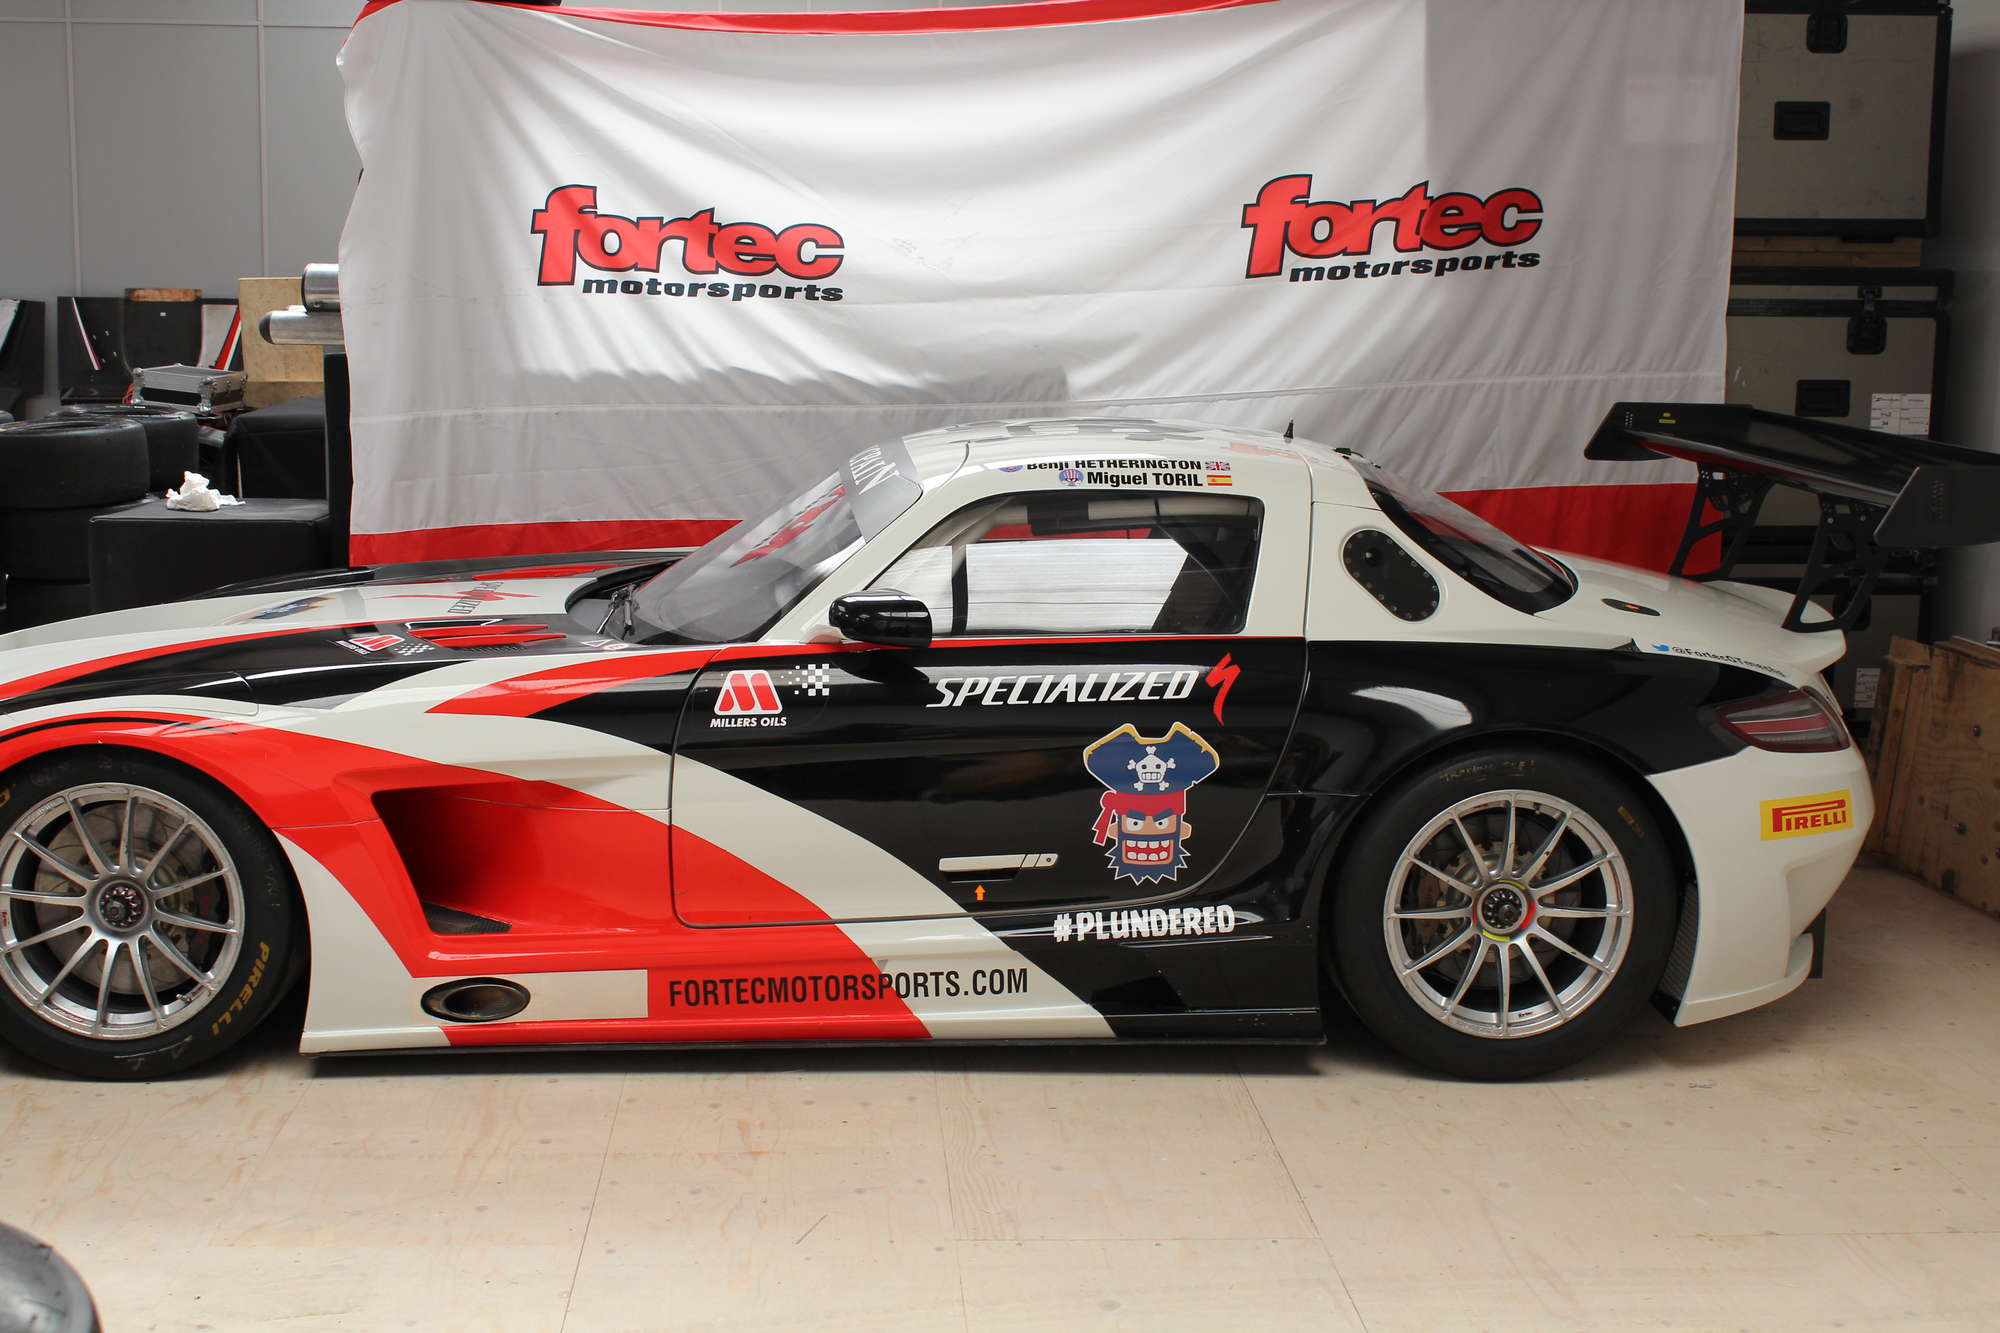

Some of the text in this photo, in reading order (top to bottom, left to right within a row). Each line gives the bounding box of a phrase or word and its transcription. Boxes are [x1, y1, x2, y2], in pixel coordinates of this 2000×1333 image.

[531, 184, 845, 286] fortec
[1241, 174, 1544, 279] fortec
[1289, 250, 1540, 282] motorsports
[582, 277, 844, 301] motorsports
[1075, 459, 1202, 470] HETHERINGTON
[1087, 471, 1203, 487] Miguel TORIL
[926, 670, 1200, 707] SPECIALIZED
[710, 717, 787, 728] MILLERS OILS
[1772, 799, 1847, 832] PIRELLI
[1053, 904, 1236, 942] #PLUNDERED
[211, 941, 270, 1036] PIRELLI
[668, 968, 1028, 1007] FORTECMOTORSPORTS.COM
